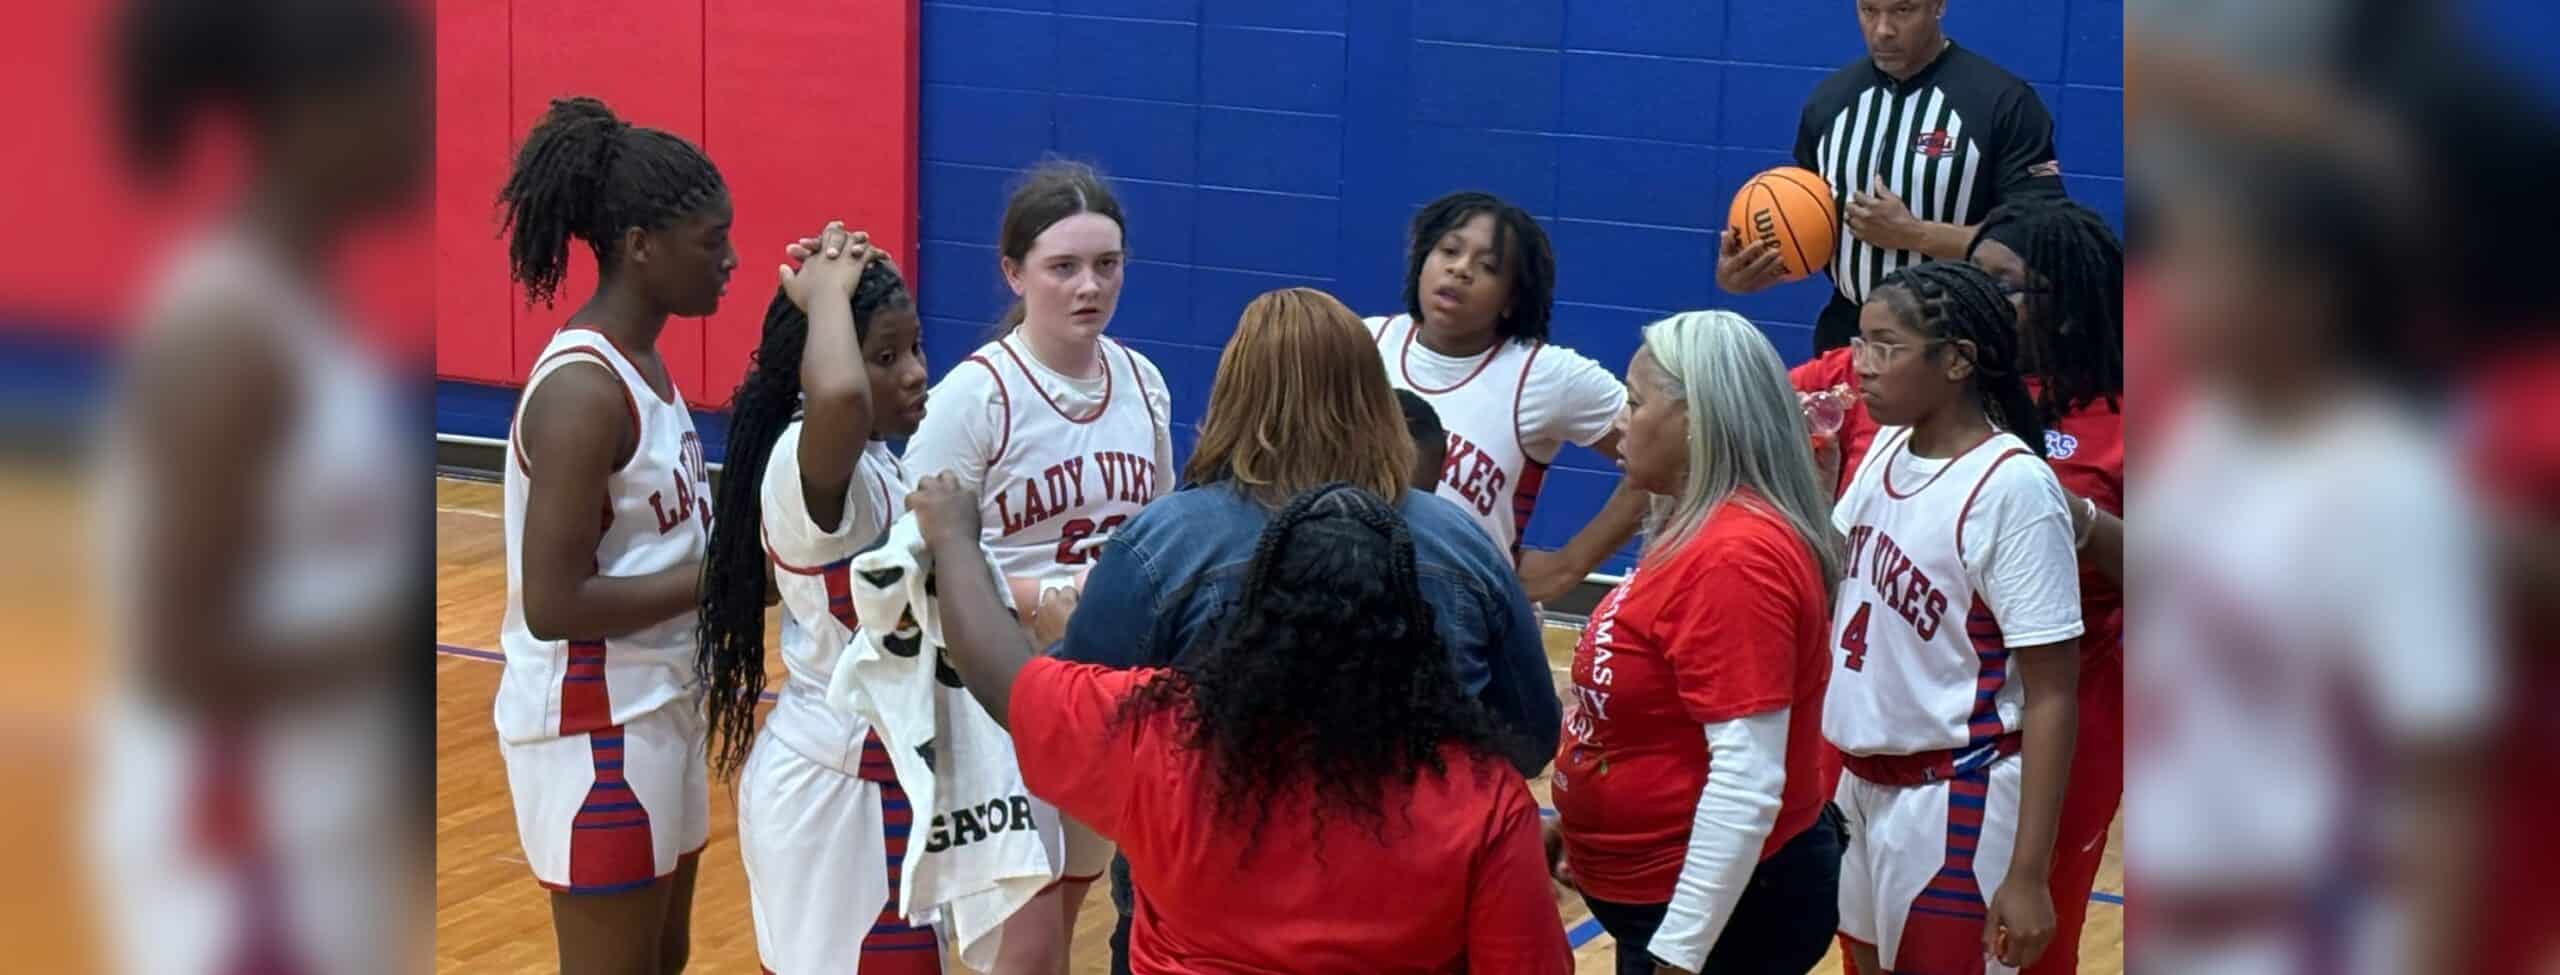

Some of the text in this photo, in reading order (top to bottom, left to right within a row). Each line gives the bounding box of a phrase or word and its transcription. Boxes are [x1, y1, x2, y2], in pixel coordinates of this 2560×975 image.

[996, 456, 1084, 536] LADY
[1872, 531, 1948, 642] VIKES
[1840, 601, 1872, 672] 4
